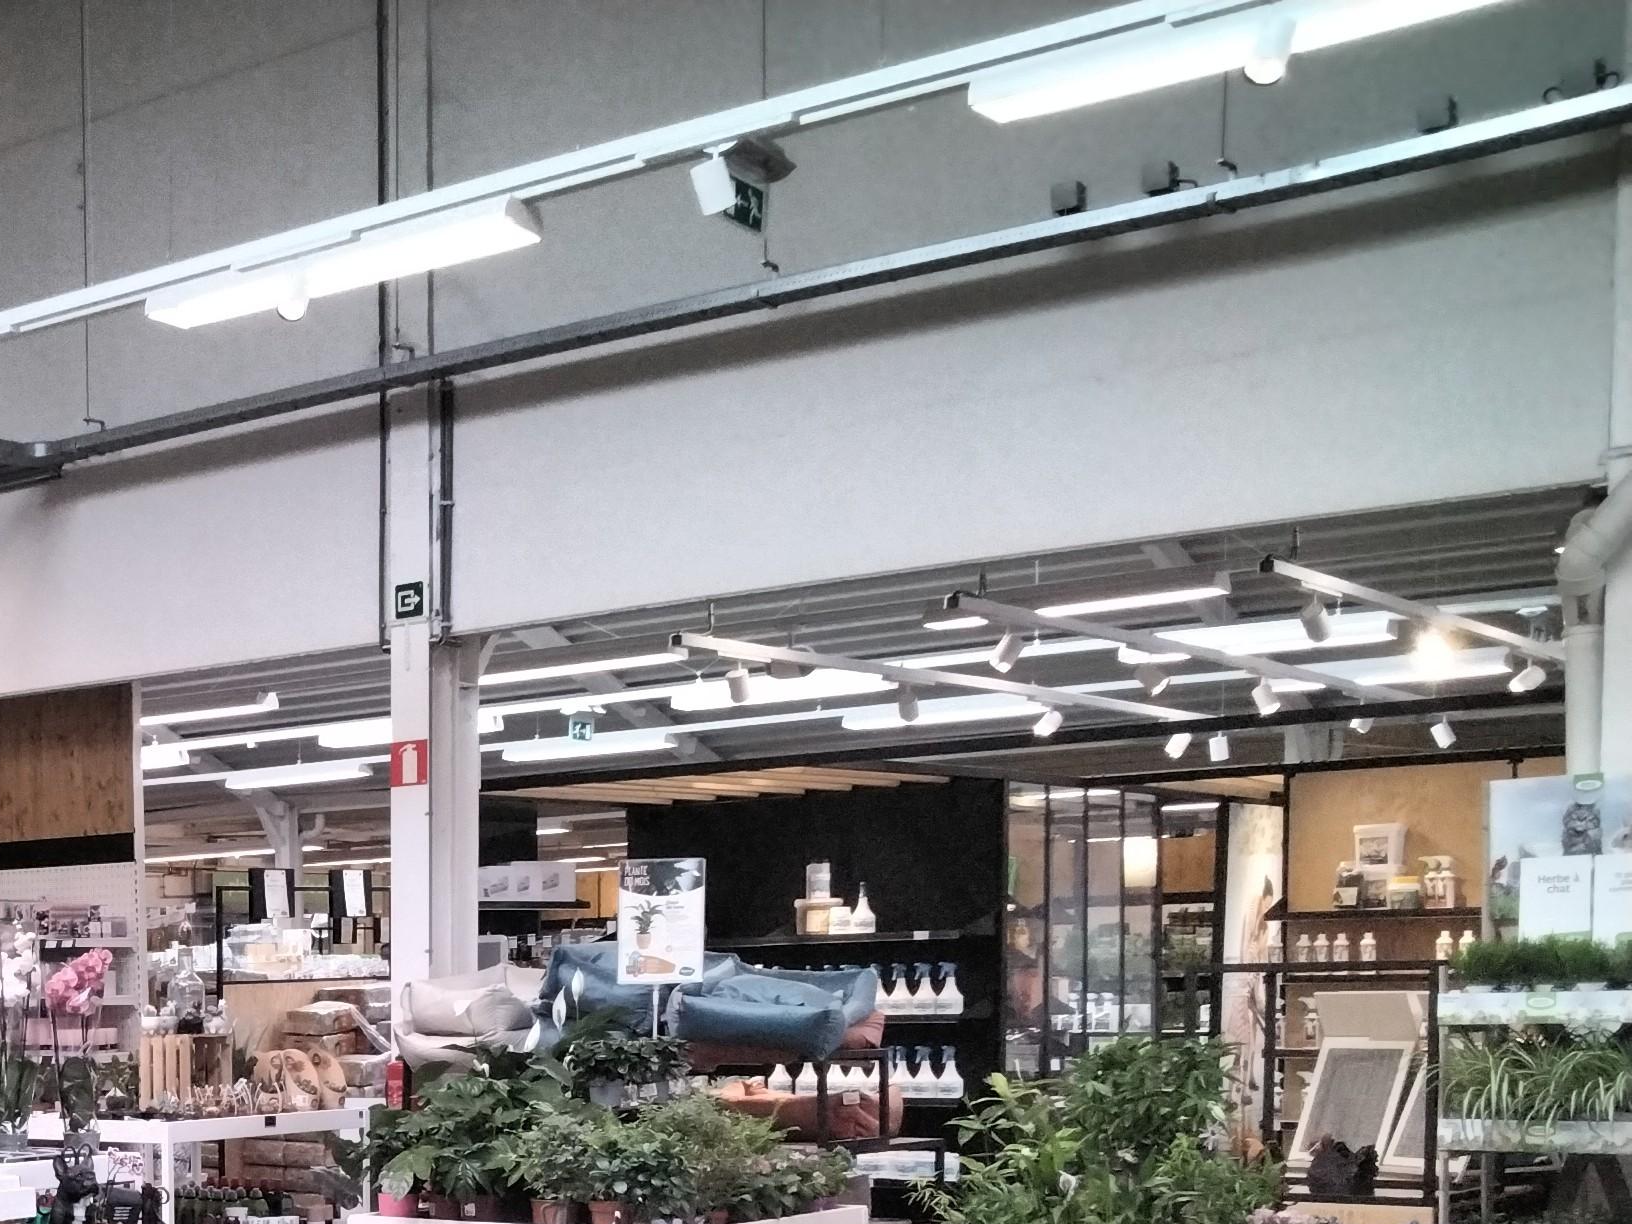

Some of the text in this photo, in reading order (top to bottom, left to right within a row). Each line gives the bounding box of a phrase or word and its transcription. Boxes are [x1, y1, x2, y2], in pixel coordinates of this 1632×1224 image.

[624, 865, 648, 876] PLANTE
[634, 876, 650, 887] MOIS
[1537, 874, 1570, 884] Herbe
[1546, 884, 1571, 894] chat
